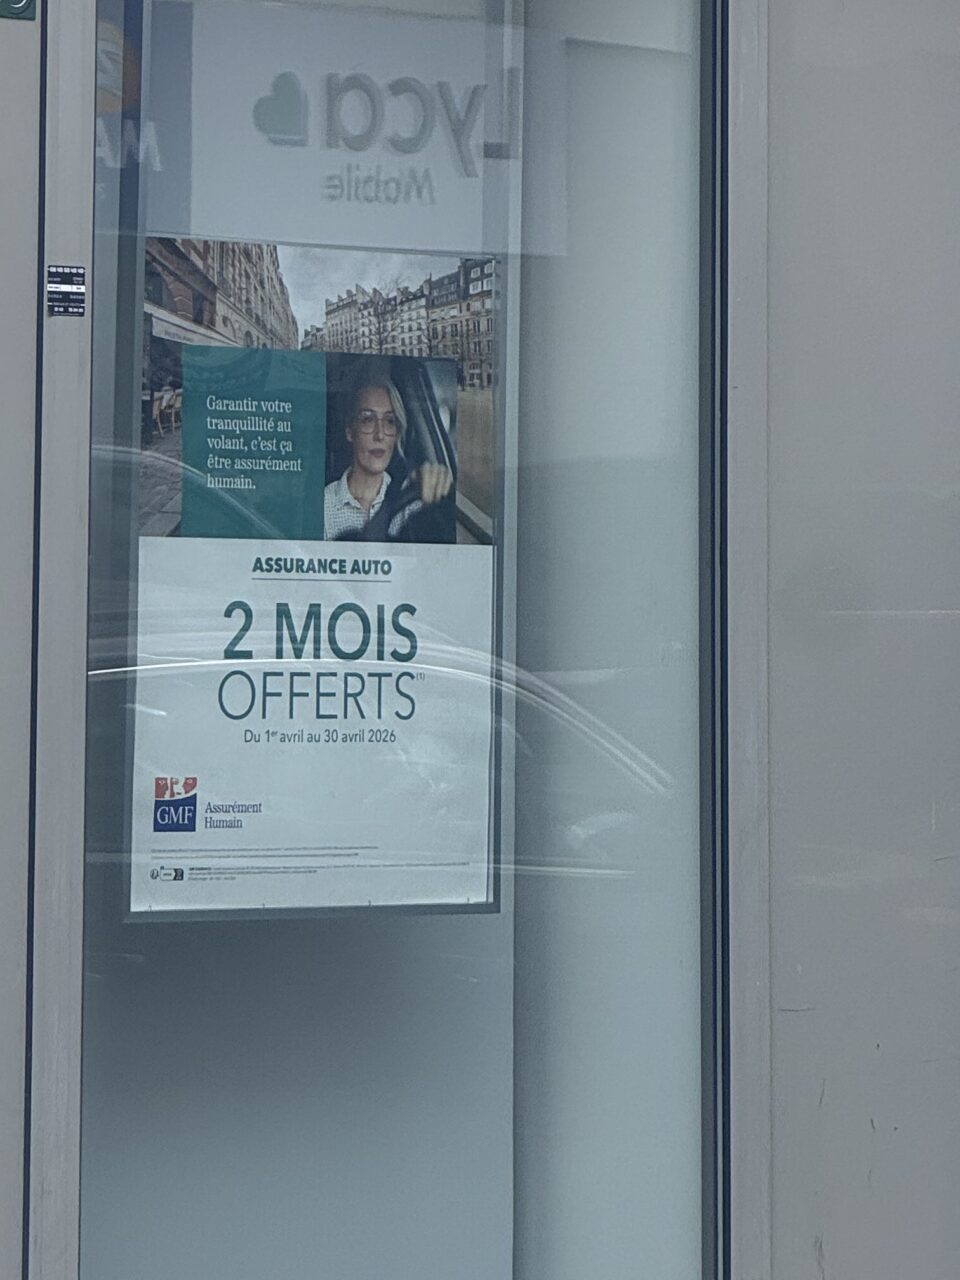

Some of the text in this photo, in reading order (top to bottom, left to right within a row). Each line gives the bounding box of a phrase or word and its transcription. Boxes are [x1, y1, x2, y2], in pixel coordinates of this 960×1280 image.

[206, 395, 292, 413] Garantir votre
[206, 416, 291, 434] tranquillité au
[207, 435, 292, 455] volant, c'est ça
[207, 454, 302, 471] être assurément
[207, 473, 256, 489] humain.
[252, 557, 392, 575] ASSURANCE AUTO
[223, 600, 418, 662] 2 MOIS
[244, 729, 396, 743] Du 1er avril au 30 avril 2026
[157, 806, 194, 825] GMF
[205, 801, 262, 814] Assurément
[204, 816, 243, 829] Humain
